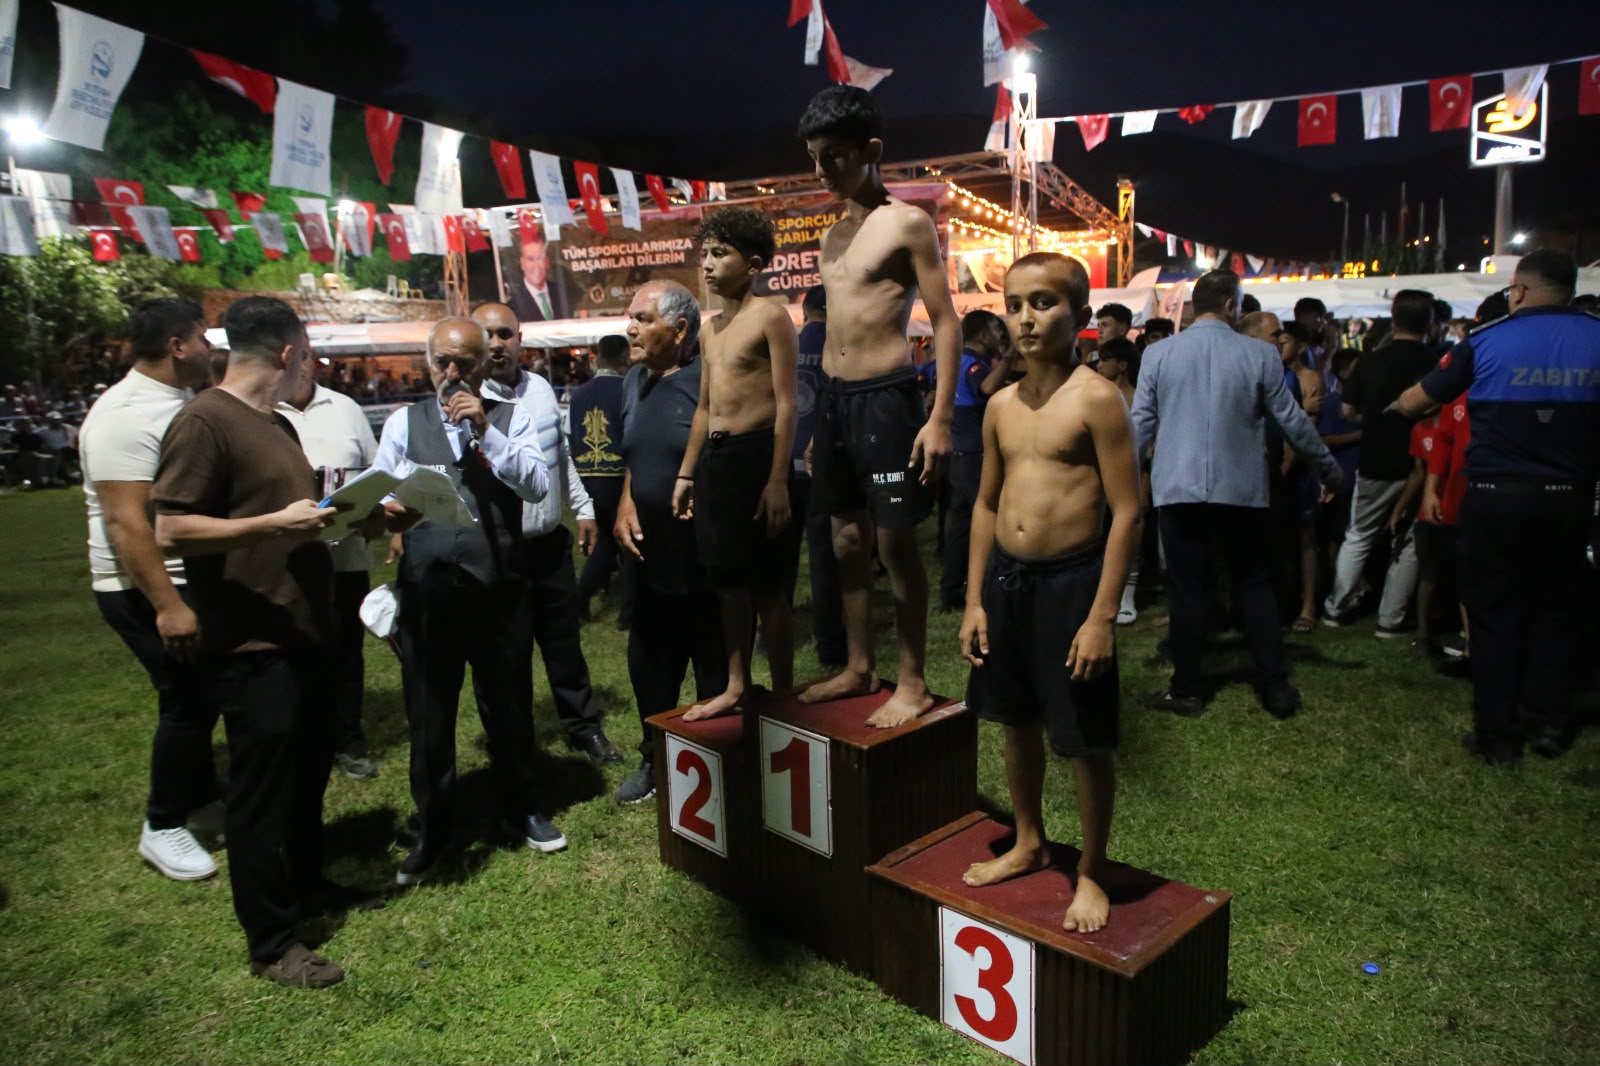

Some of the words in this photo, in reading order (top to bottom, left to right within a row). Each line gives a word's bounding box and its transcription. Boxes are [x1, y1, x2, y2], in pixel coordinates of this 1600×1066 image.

[774, 227, 828, 248] ŞARILA
[562, 245, 587, 260] TÜM
[588, 238, 693, 258] SPORCULARIMIZA
[571, 256, 635, 273] BAŞARILAR
[637, 252, 685, 266] DİLERİM
[887, 471, 905, 483] KURT
[676, 749, 716, 843] 2
[770, 736, 812, 838] 1
[953, 925, 1018, 1042] 3
